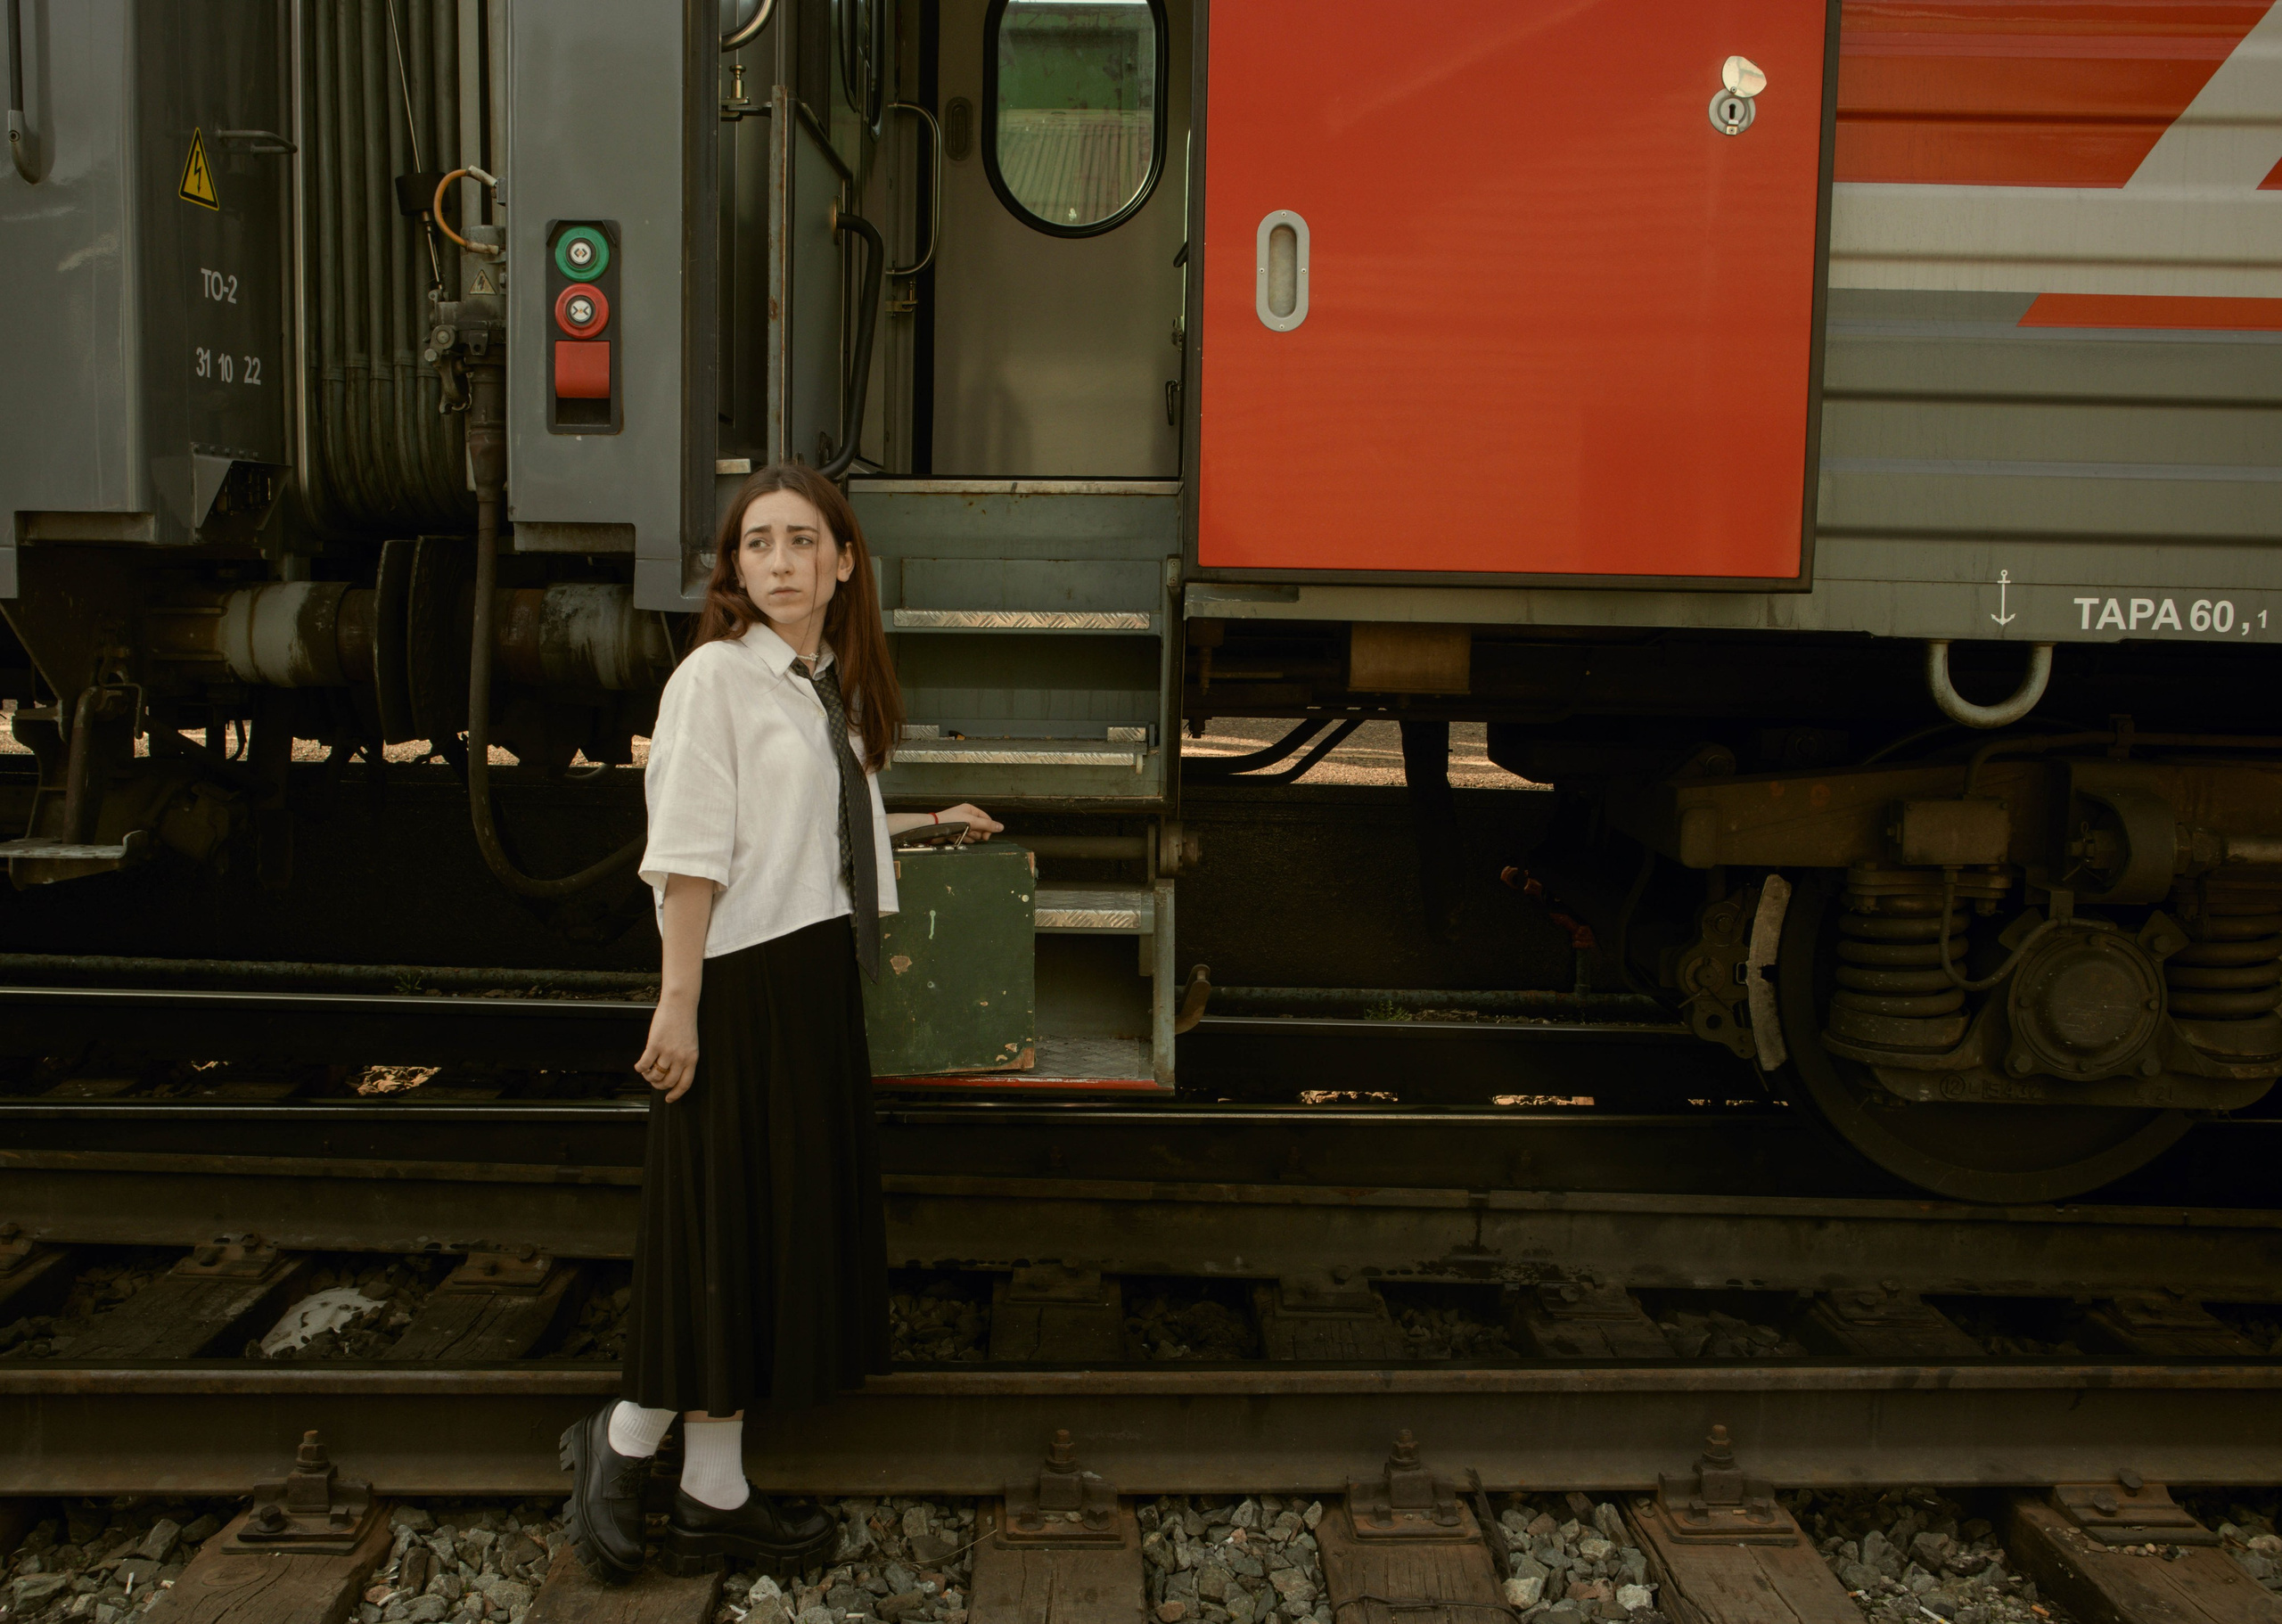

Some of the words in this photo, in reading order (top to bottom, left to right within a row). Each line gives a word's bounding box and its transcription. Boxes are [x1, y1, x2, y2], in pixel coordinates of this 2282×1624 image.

[201, 267, 238, 304] ТО-2
[196, 347, 210, 378] 31
[218, 353, 234, 383] 10
[243, 356, 261, 385] 22
[2073, 597, 2183, 631] ТАРА
